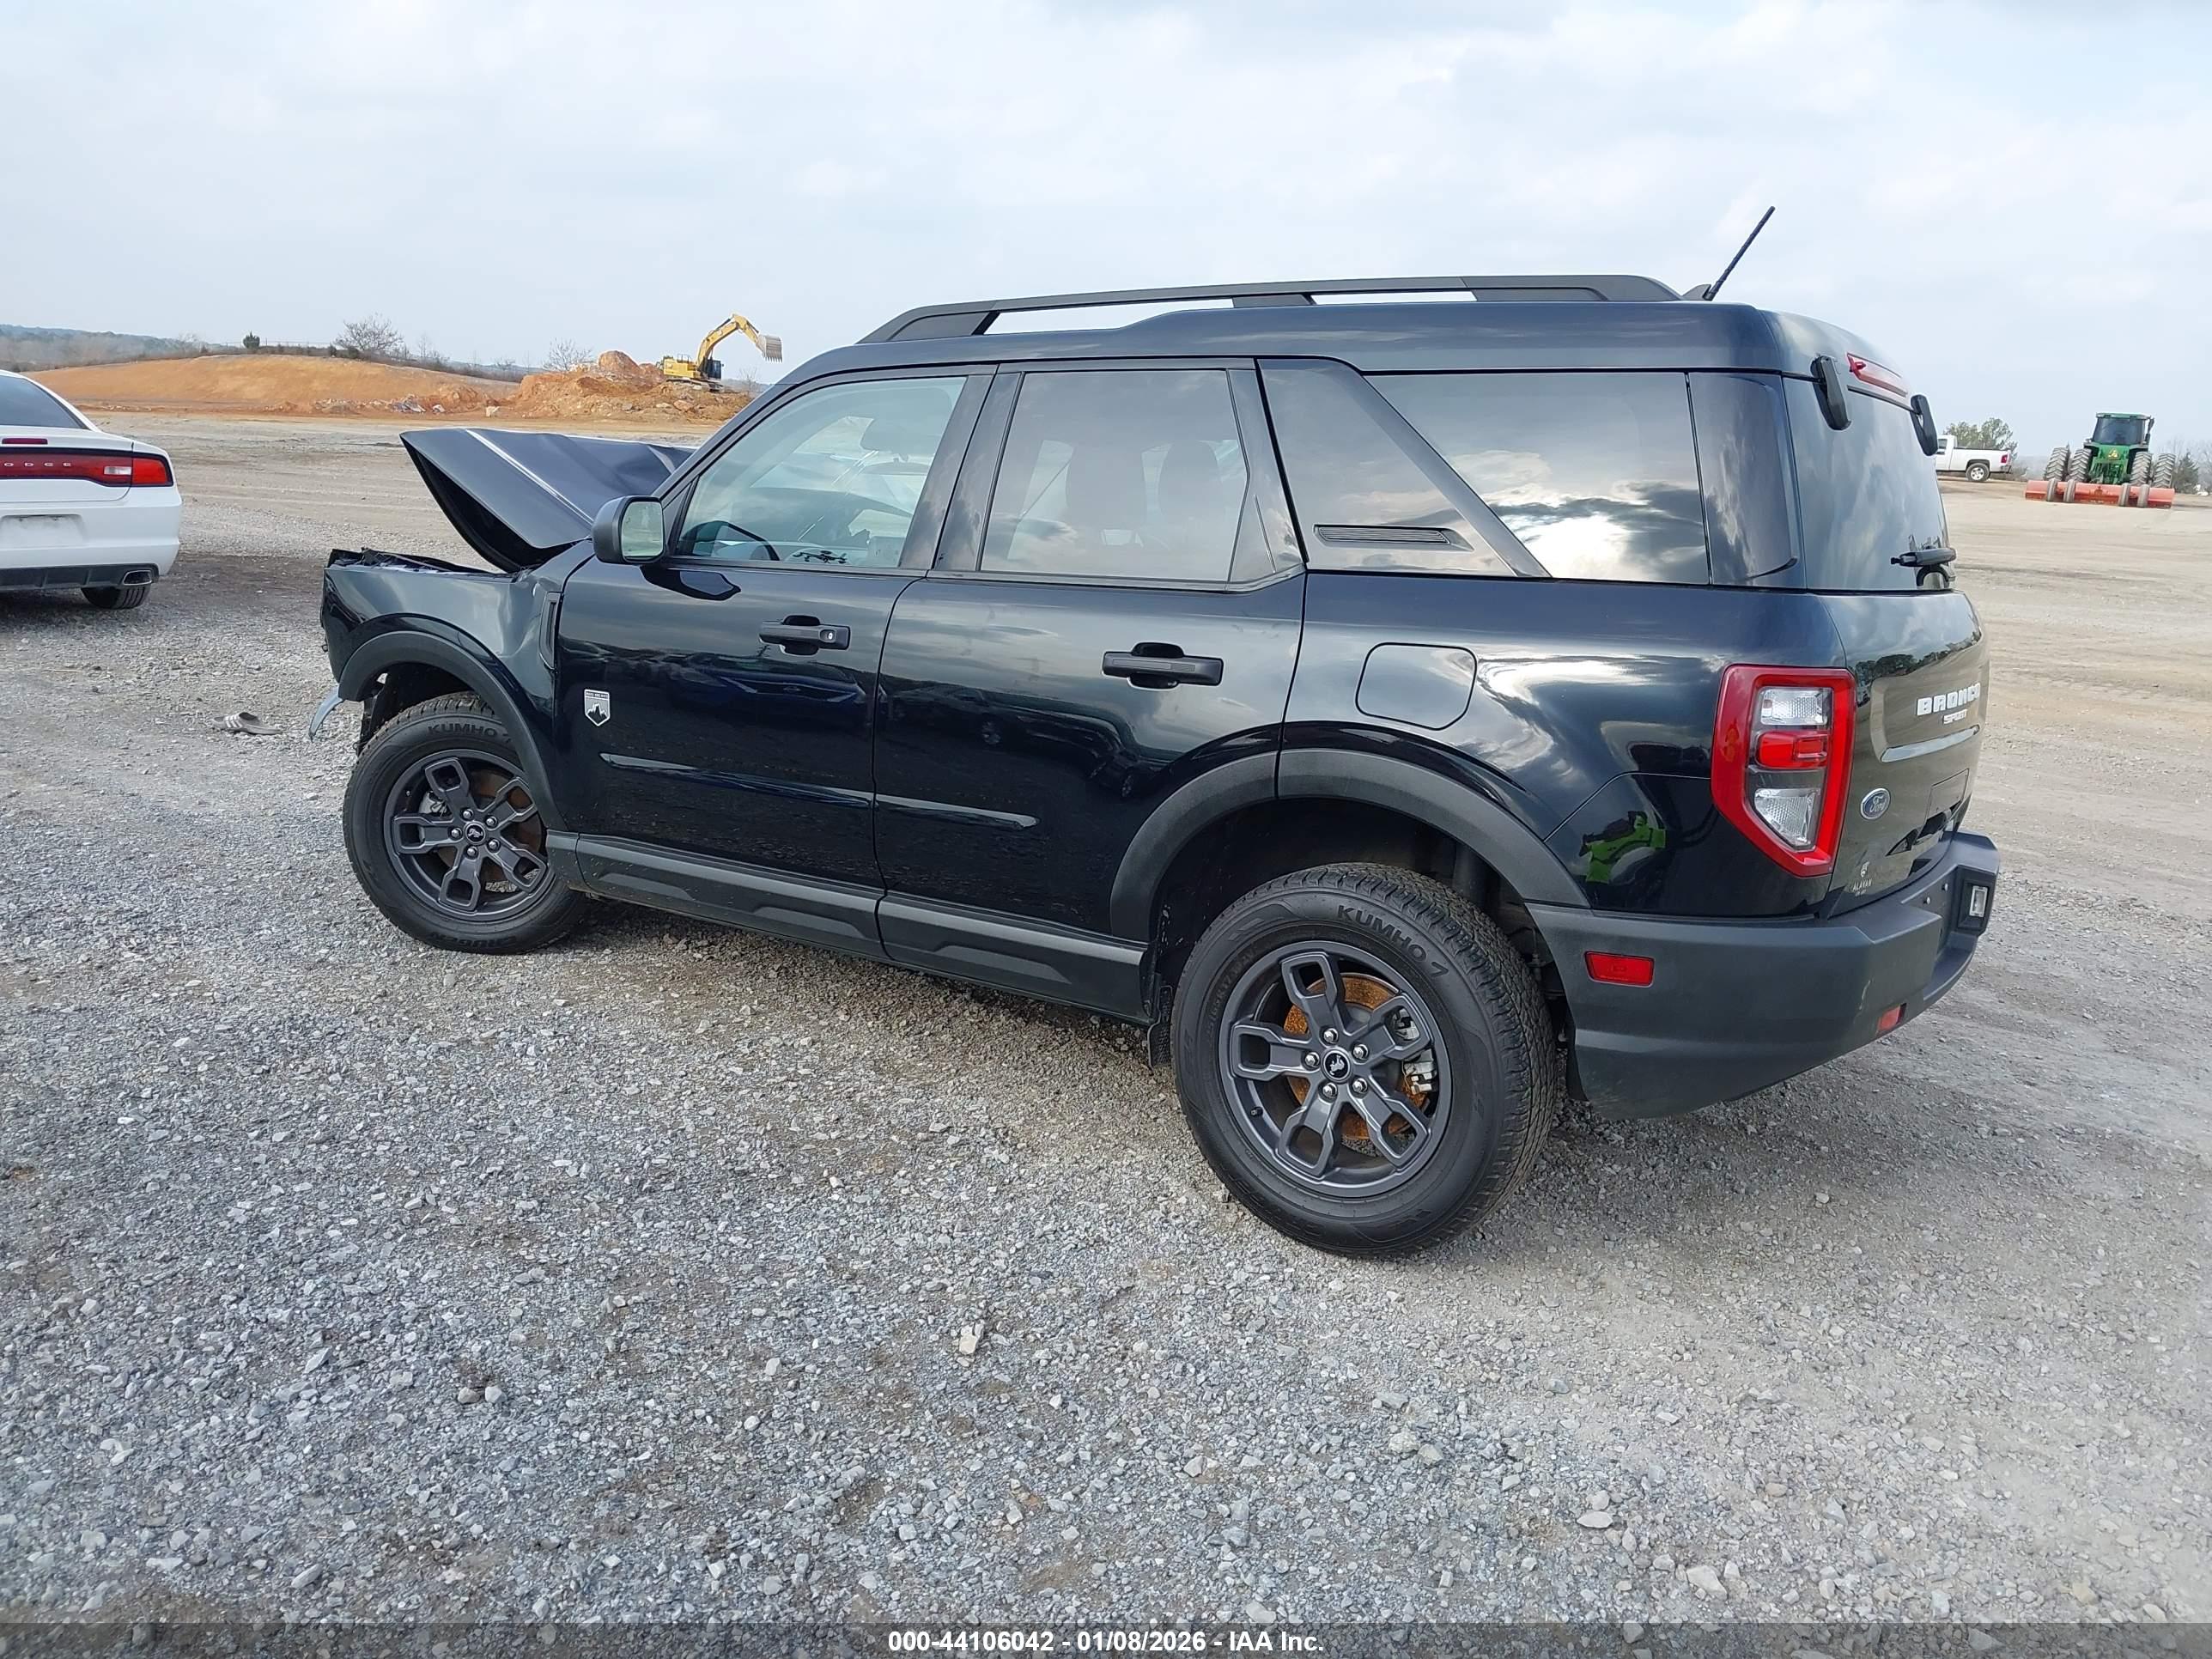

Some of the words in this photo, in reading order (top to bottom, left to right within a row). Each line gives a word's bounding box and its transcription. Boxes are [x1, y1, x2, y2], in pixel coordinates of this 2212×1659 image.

[1917, 683, 1980, 715] BRONCO
[427, 721, 498, 737] KUMHO
[1337, 904, 1427, 962] KUMHO
